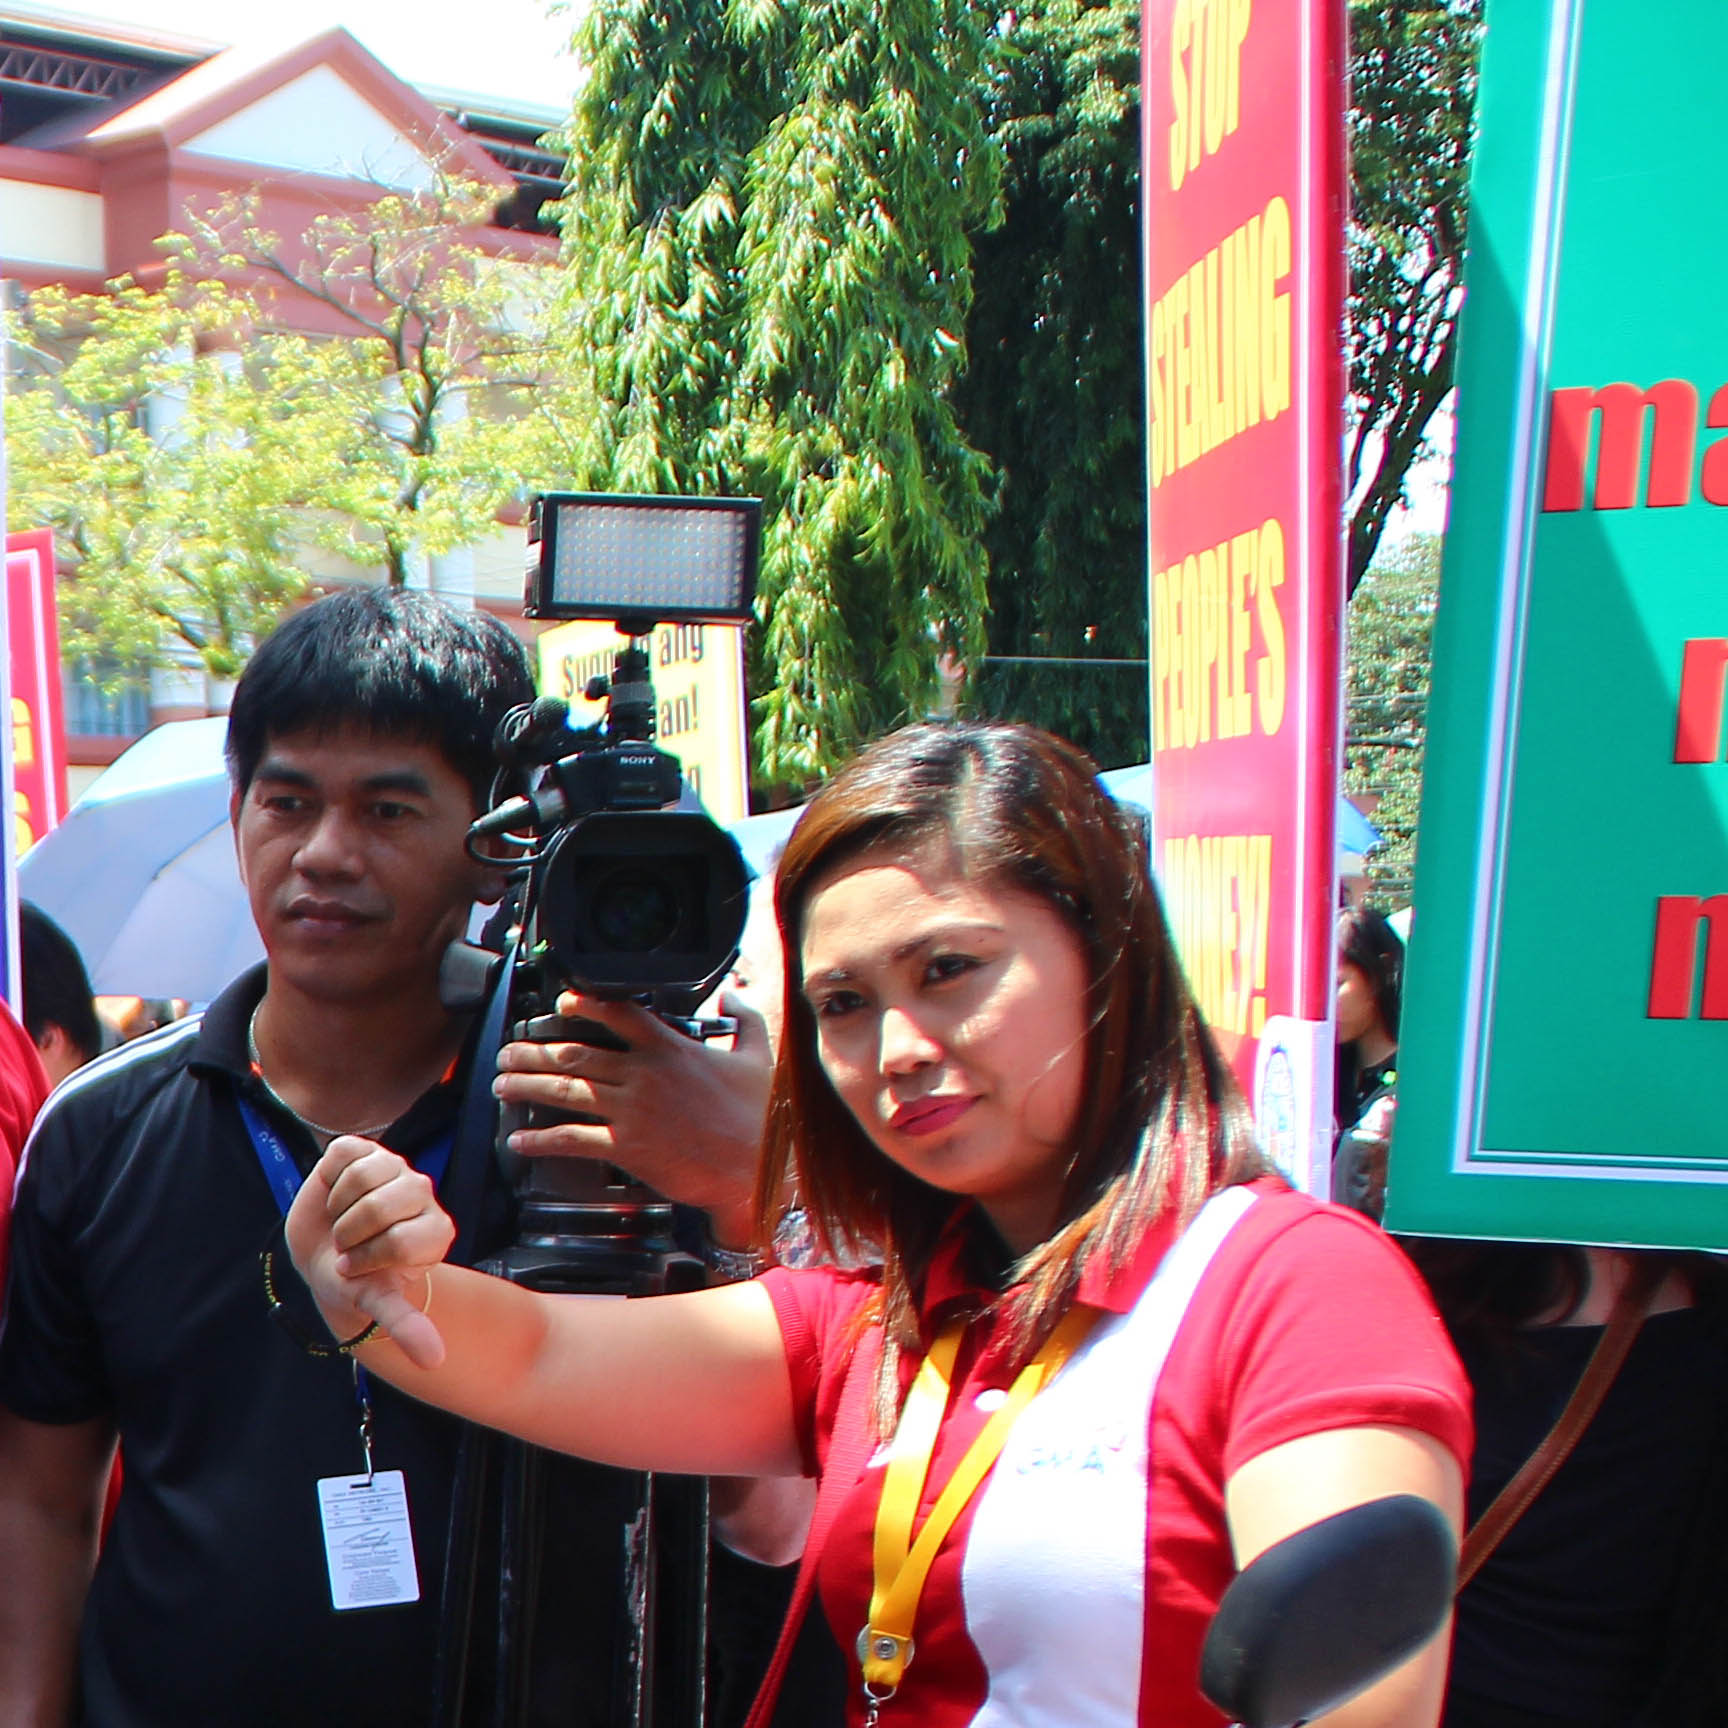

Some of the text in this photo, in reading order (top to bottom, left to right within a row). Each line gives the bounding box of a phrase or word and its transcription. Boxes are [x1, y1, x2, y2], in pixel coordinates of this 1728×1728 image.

[1152, 196, 1290, 488] STEALING
[1154, 518, 1286, 752] PEOPLE'S
[619, 755, 656, 765] SONY
